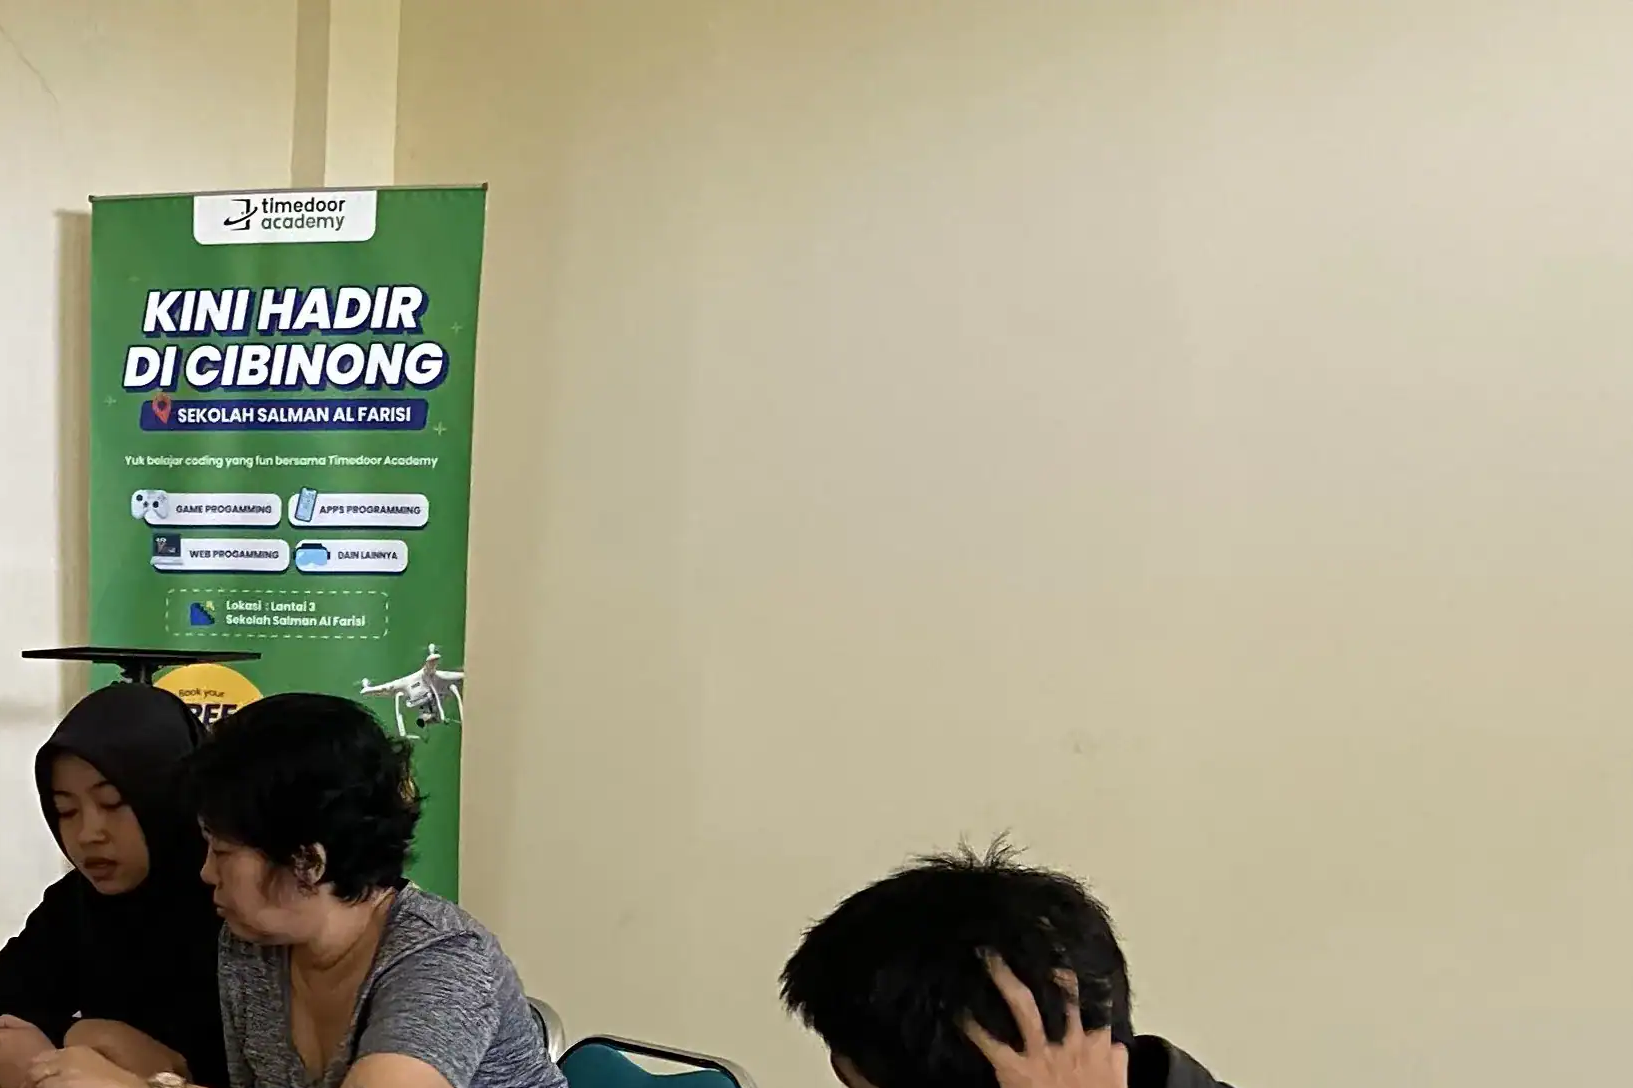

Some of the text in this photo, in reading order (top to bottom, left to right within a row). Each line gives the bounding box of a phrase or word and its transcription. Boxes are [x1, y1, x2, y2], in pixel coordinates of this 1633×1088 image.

[261, 196, 346, 214] timedoor
[261, 213, 345, 231] academy
[143, 286, 423, 333] KINI HADIR
[122, 342, 444, 388] DI CIBINONG
[177, 405, 411, 424] SEKOLAH SALMAN AL FARISI
[124, 454, 439, 469] Yuk belajar coding yang fun bersama Timedoor Academy
[175, 504, 204, 514] GAME
[319, 505, 421, 515] APPS PROGRAMMING
[189, 549, 212, 559] WEB
[226, 599, 262, 611] Lokasi
[270, 601, 308, 612] Lantai
[308, 602, 316, 612] 3
[226, 614, 366, 627] Sekolah Salman Al Farisi
[203, 689, 225, 699] your
